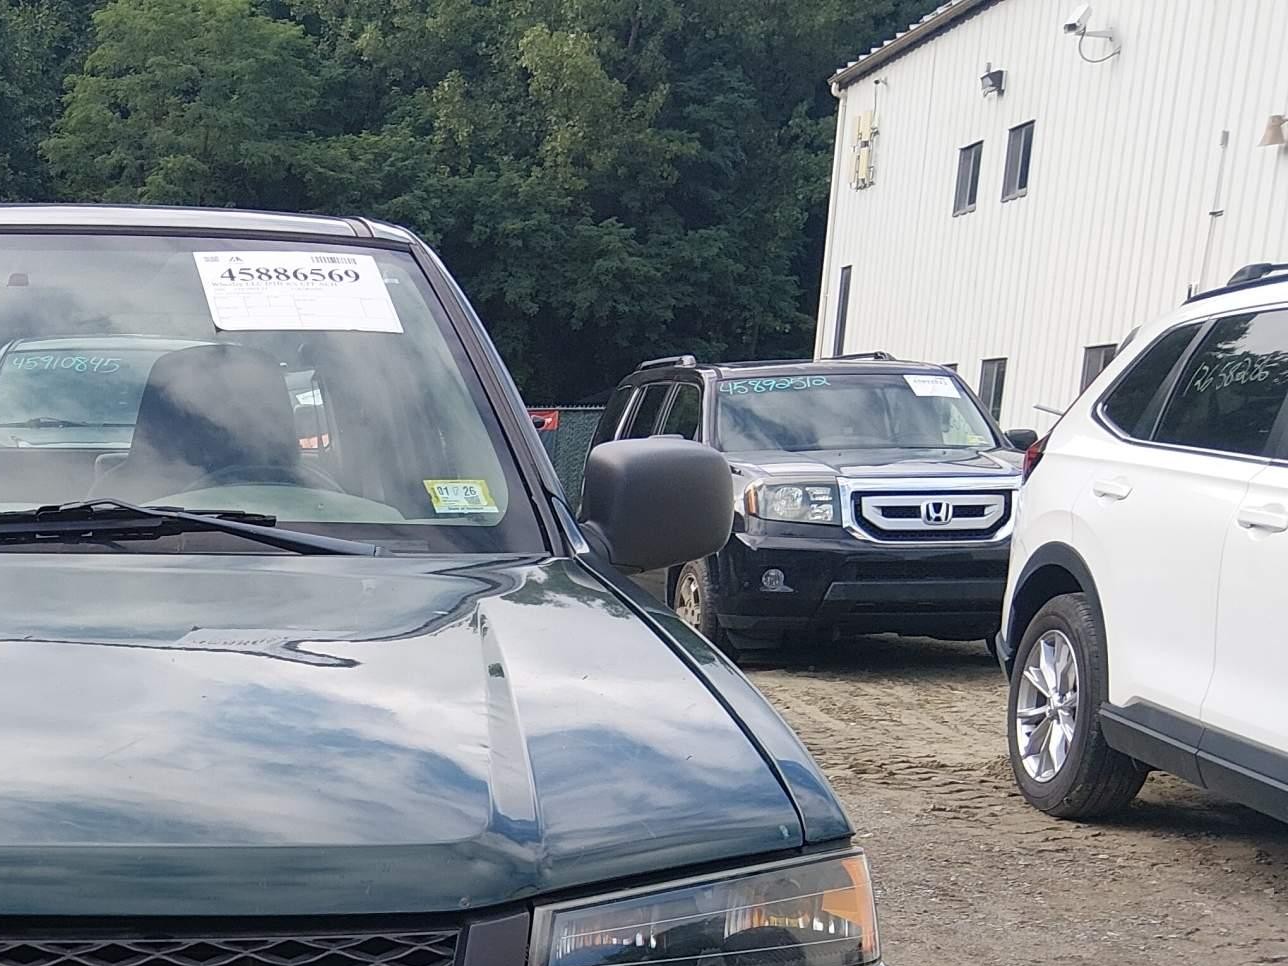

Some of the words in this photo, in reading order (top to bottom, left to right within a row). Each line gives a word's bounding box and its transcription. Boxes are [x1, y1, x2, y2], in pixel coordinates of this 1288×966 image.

[220, 267, 361, 284] 45886569
[12, 354, 123, 374] 45910845
[719, 375, 831, 396] 45892512
[463, 486, 477, 496] 26
